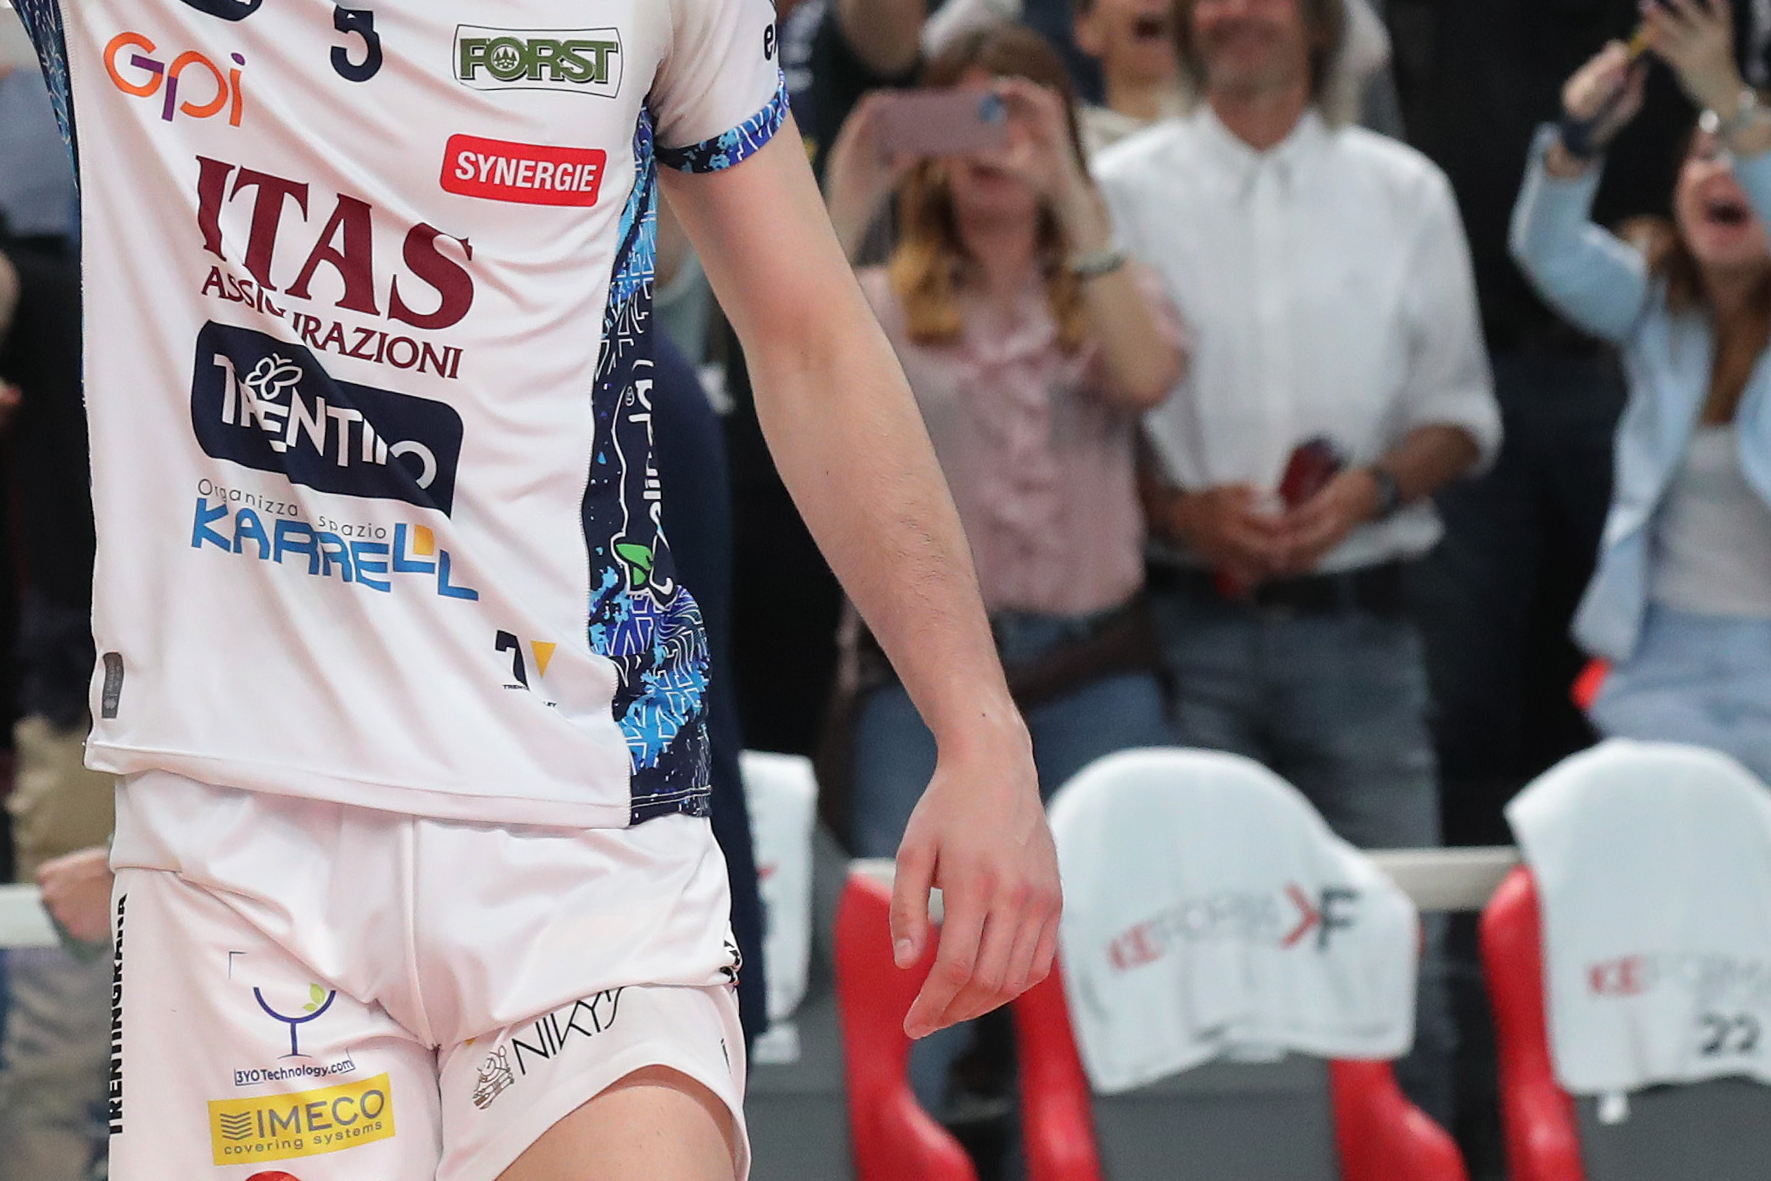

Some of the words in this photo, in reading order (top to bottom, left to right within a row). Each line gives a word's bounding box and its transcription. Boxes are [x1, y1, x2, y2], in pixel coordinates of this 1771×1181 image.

[330, 4, 384, 83] 5
[460, 35, 620, 85] FORST
[454, 150, 597, 193] SYNERGIE
[195, 154, 475, 330] ITAS
[197, 478, 298, 517] Organizza
[318, 515, 387, 539] spazio
[191, 497, 479, 601] KARRELL
[223, 1138, 304, 1155] covering
[313, 1121, 383, 1145] systems
[256, 1088, 385, 1139] IMECO
